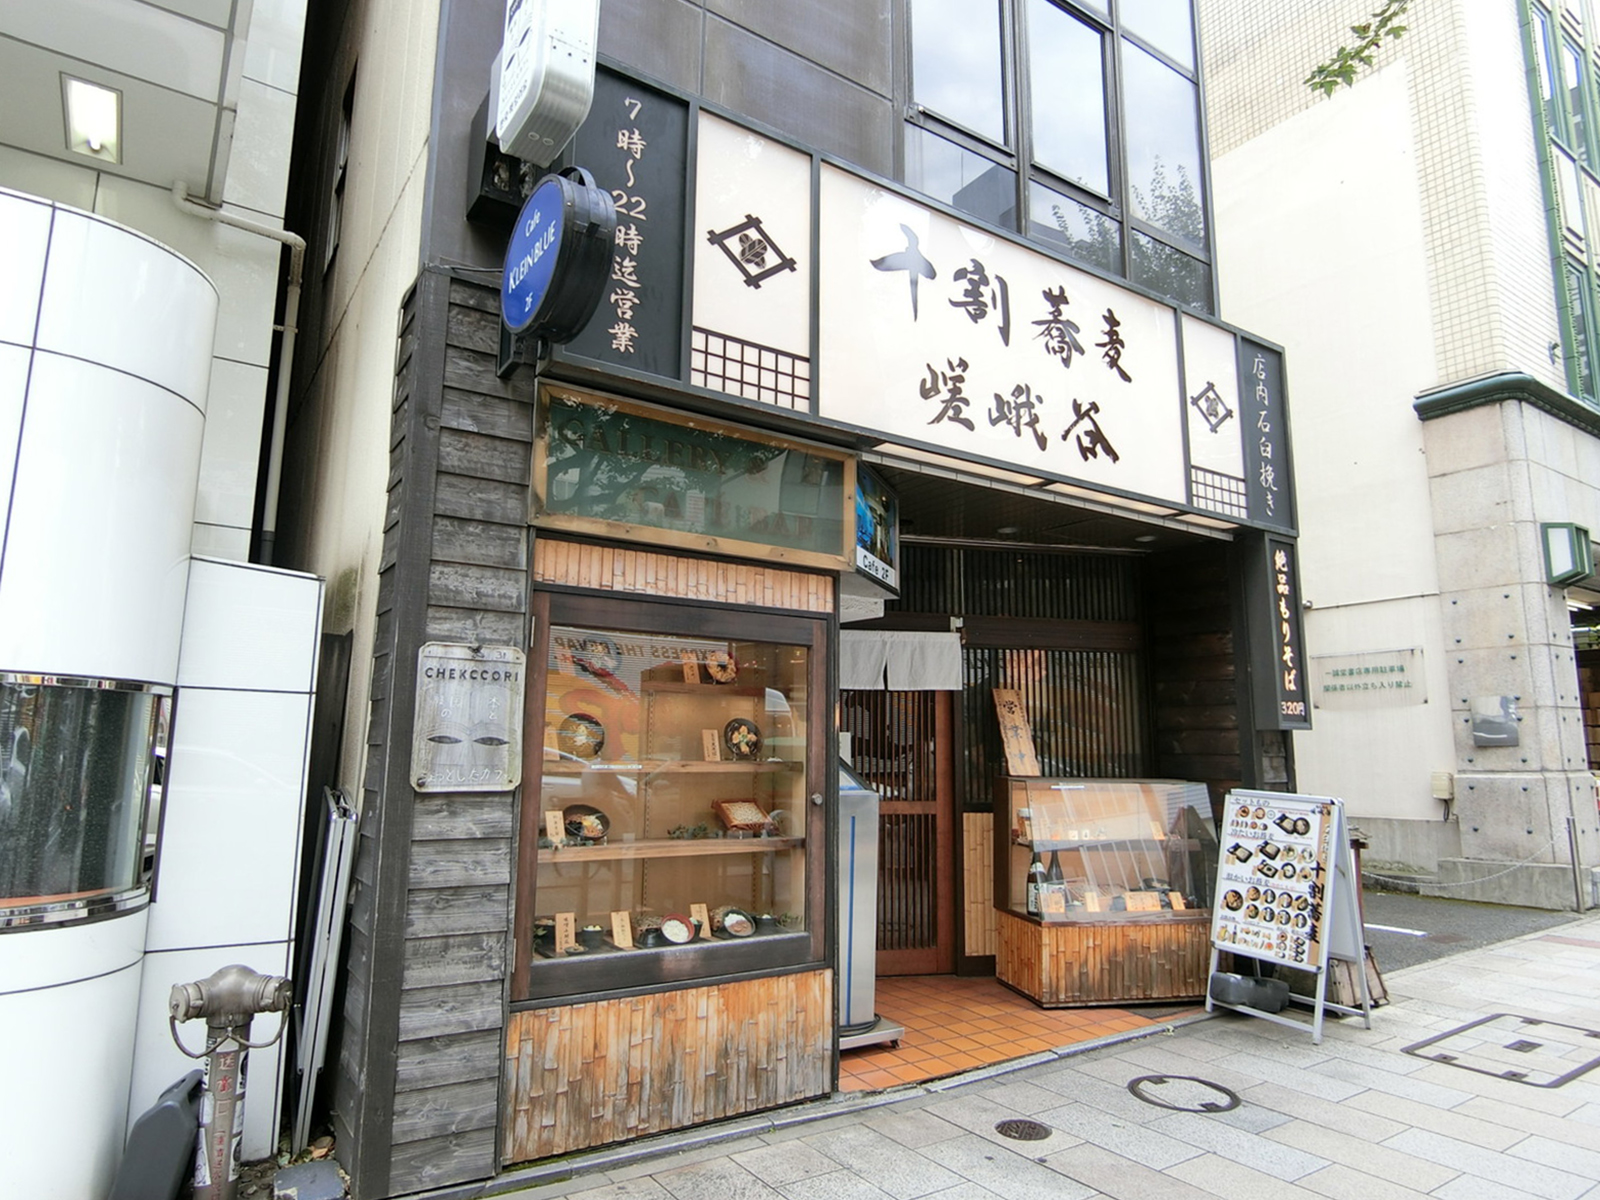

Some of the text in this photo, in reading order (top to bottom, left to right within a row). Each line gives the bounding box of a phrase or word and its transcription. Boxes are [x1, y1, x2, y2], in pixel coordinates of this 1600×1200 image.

[525, 208, 541, 237] Cafe
[525, 292, 533, 313] 2F
[869, 223, 1132, 384] 十割蕎麦
[919, 357, 1120, 464] 嵯峨谷
[1252, 353, 1279, 516] 店内石臼挽き
[863, 555, 889, 581] Cafe 2F
[1274, 549, 1297, 691] 絶品もりそば
[424, 667, 519, 682] CHEKCCORI
[1281, 700, 1305, 716] 320円
